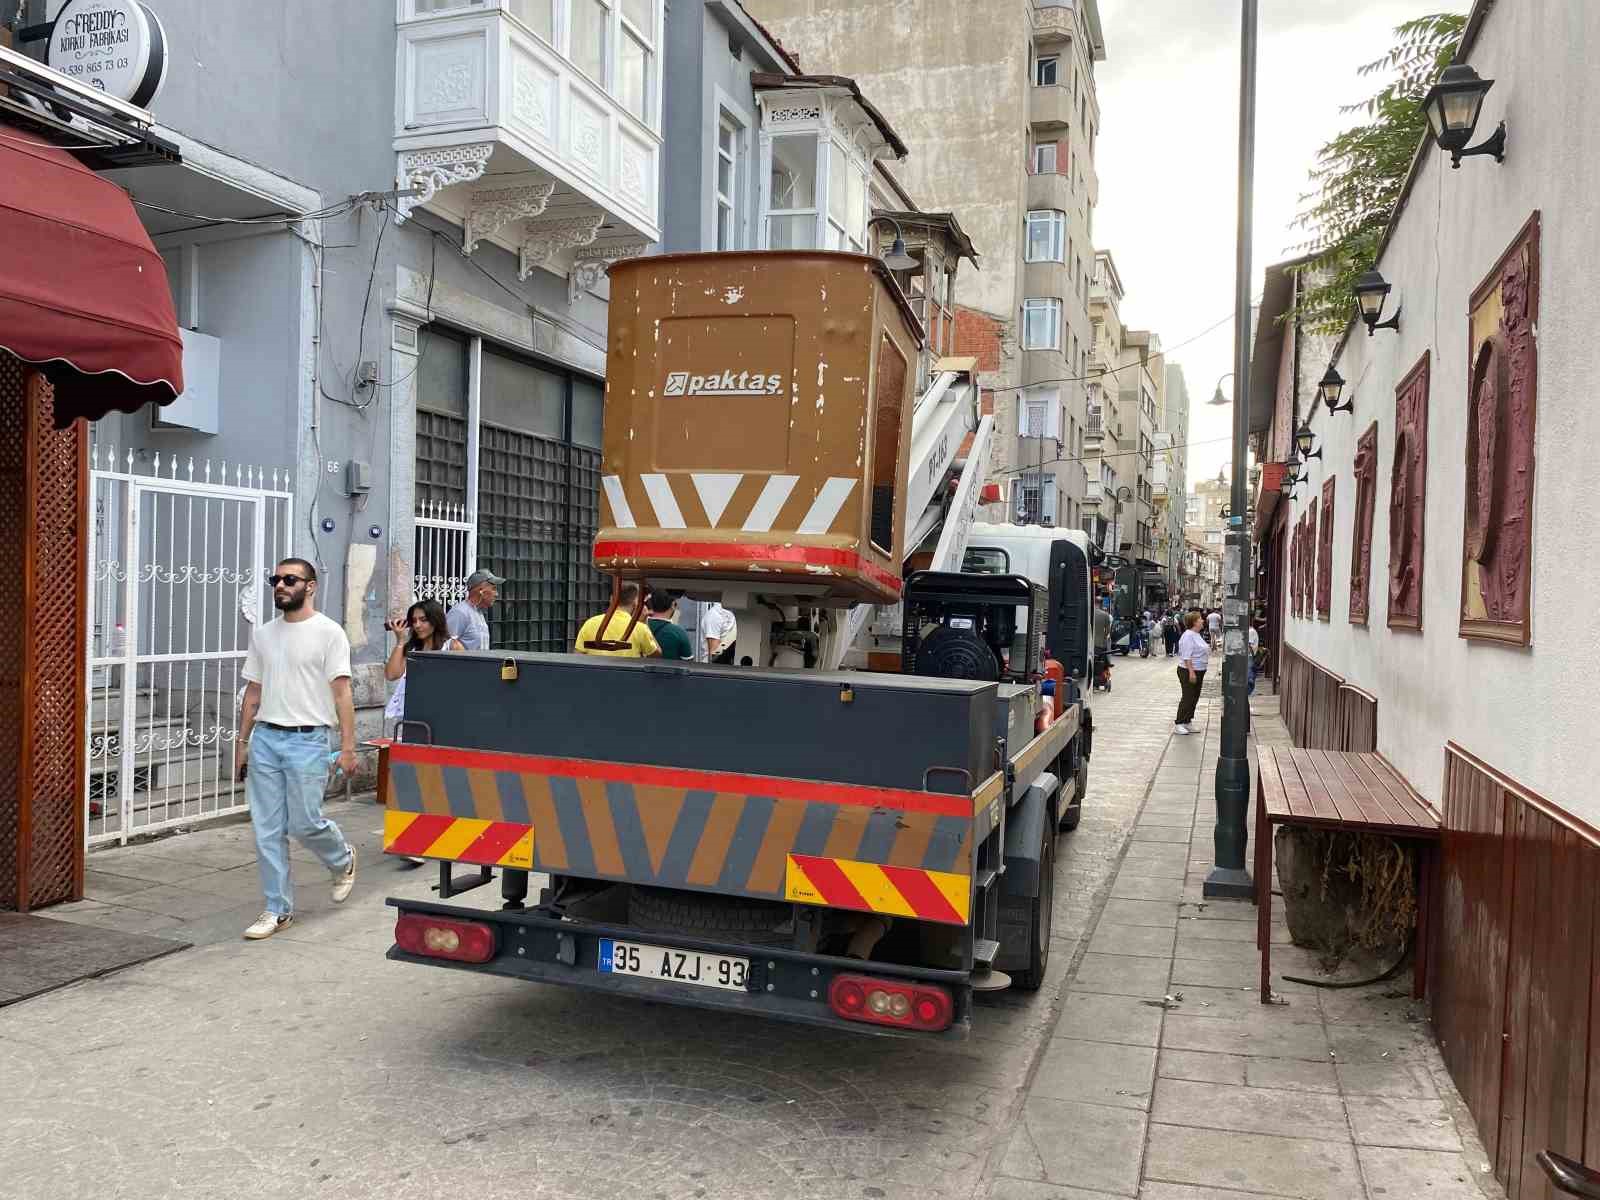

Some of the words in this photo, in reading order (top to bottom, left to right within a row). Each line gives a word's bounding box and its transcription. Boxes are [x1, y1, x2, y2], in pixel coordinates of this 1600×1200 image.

[65, 9, 126, 34] FREDDY
[89, 28, 129, 48] FABRİKASI
[69, 64, 84, 76] 539
[86, 61, 103, 73] 865
[105, 59, 114, 71] 73
[117, 57, 129, 69] 03
[689, 369, 784, 395] paktaş
[602, 958, 612, 966] TR
[615, 945, 640, 972] 35
[661, 951, 701, 981] AZJ
[718, 959, 750, 987] 93
